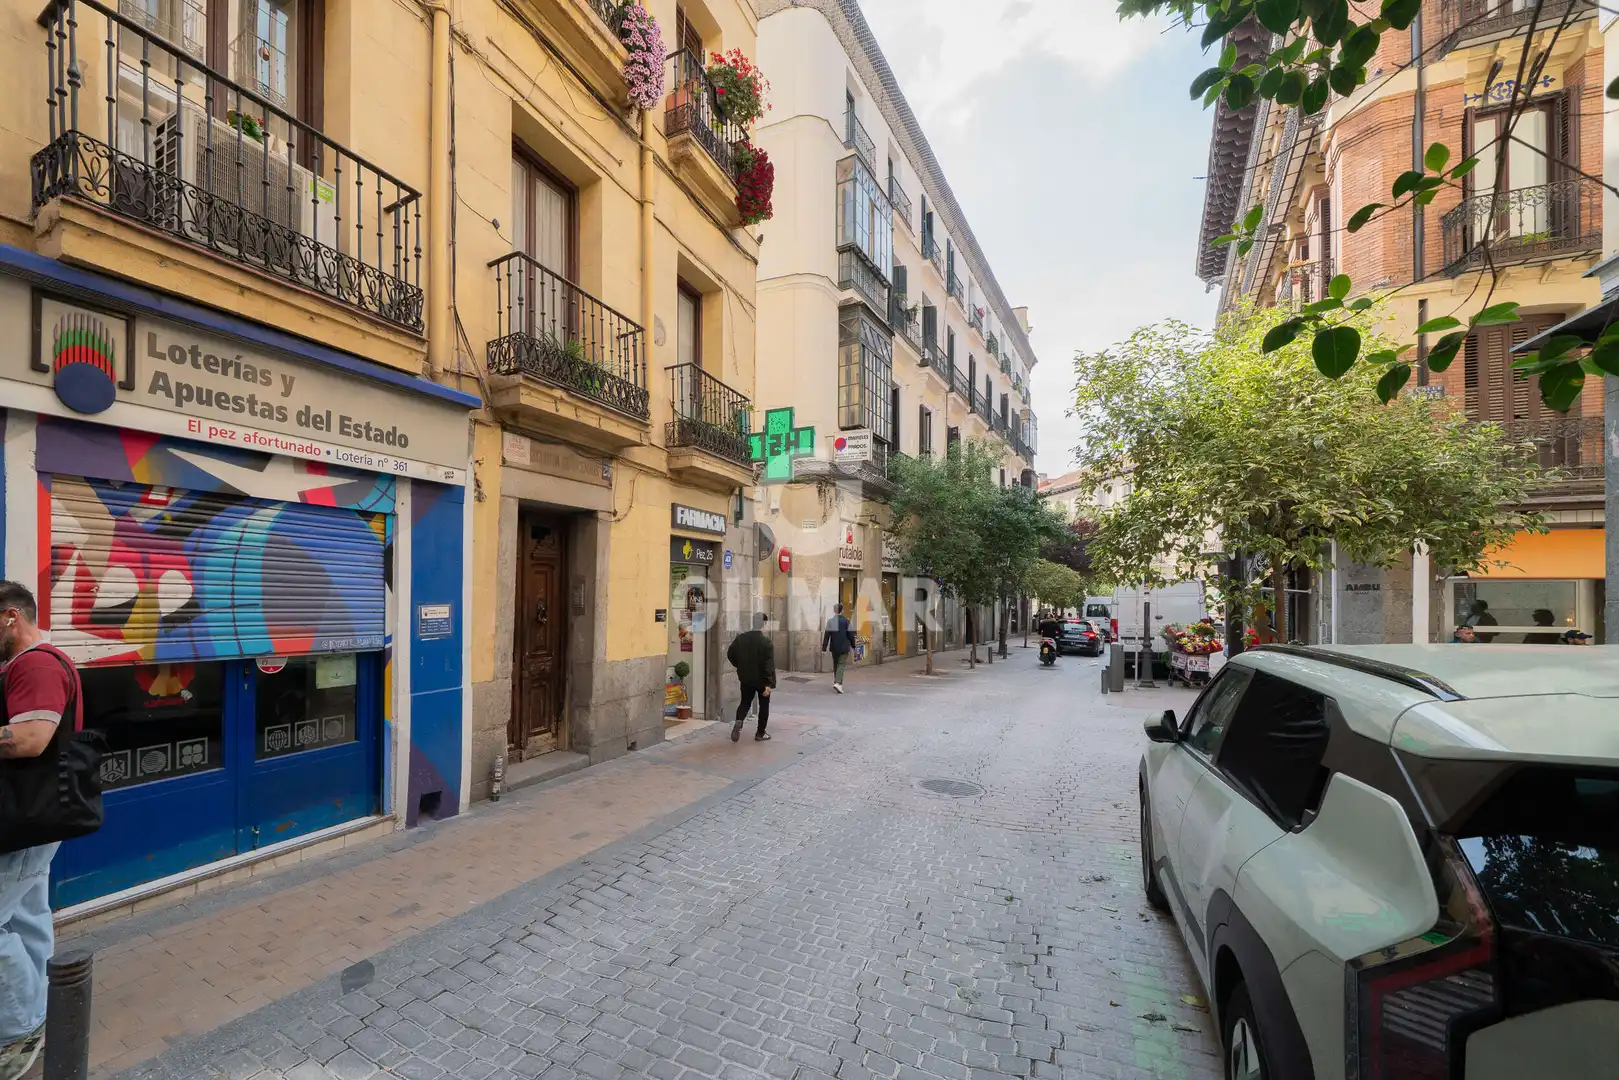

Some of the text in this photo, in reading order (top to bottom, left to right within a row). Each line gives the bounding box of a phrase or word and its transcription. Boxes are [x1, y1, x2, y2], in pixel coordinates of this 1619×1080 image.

[147, 332, 296, 397] Loterías y
[147, 370, 409, 449] Apuestas del Estado
[187, 419, 201, 433] El
[208, 426, 236, 441] pez
[243, 432, 321, 456] afortunado
[392, 460, 408, 472] 361
[677, 506, 726, 533] FARMACIA
